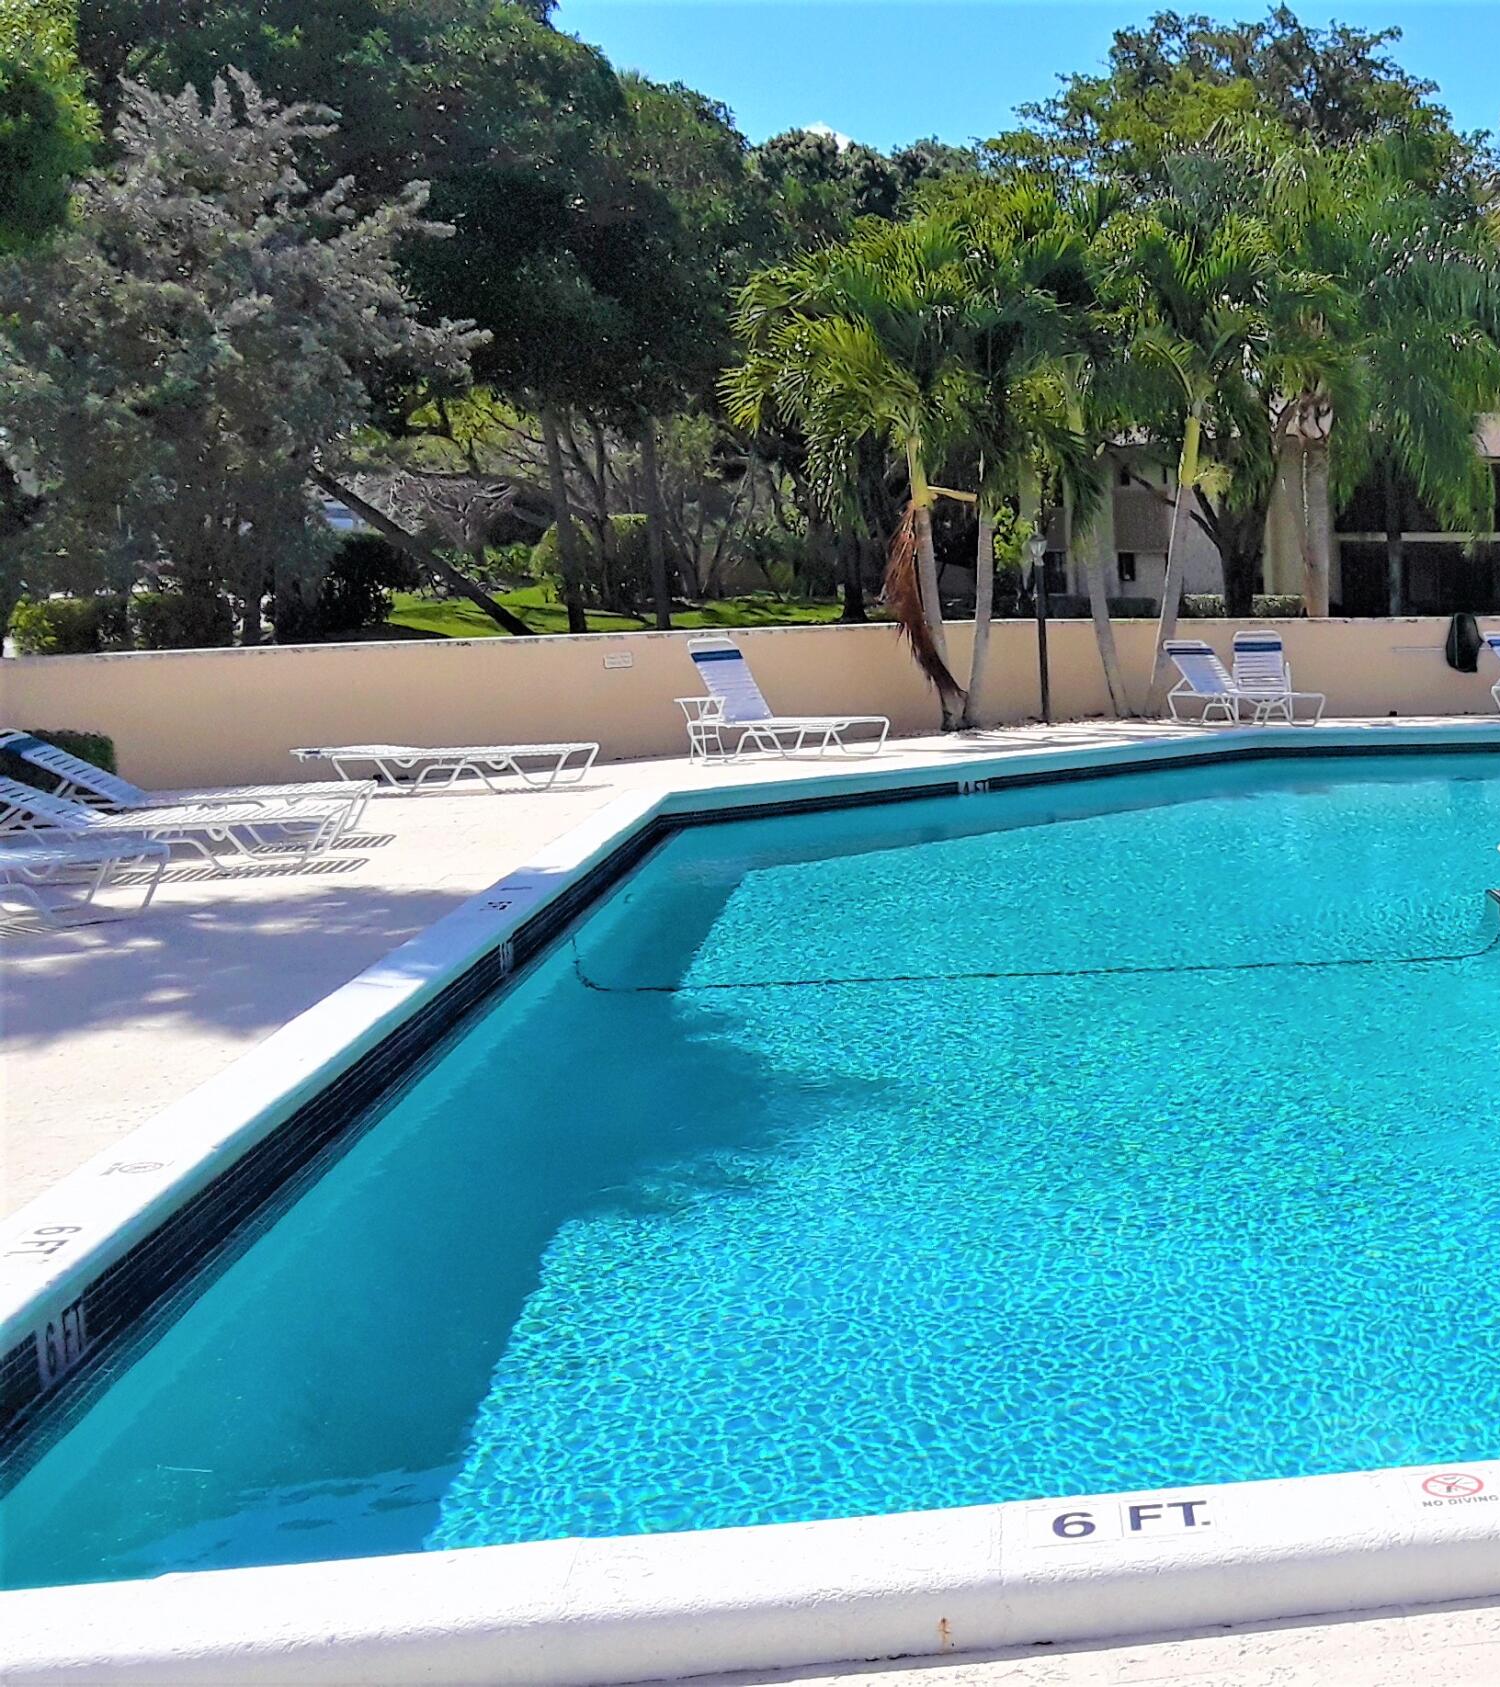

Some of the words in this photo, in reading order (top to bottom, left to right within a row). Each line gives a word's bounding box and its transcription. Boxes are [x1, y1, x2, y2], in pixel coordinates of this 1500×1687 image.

[33, 1226, 83, 1235] 6
[46, 1322, 57, 1378] 6
[62, 1296, 82, 1364] FT
[1422, 1500, 1443, 1508] NO
[1448, 1494, 1499, 1506] DIVING
[1052, 1512, 1096, 1538] 6
[1129, 1500, 1211, 1531] FT.
